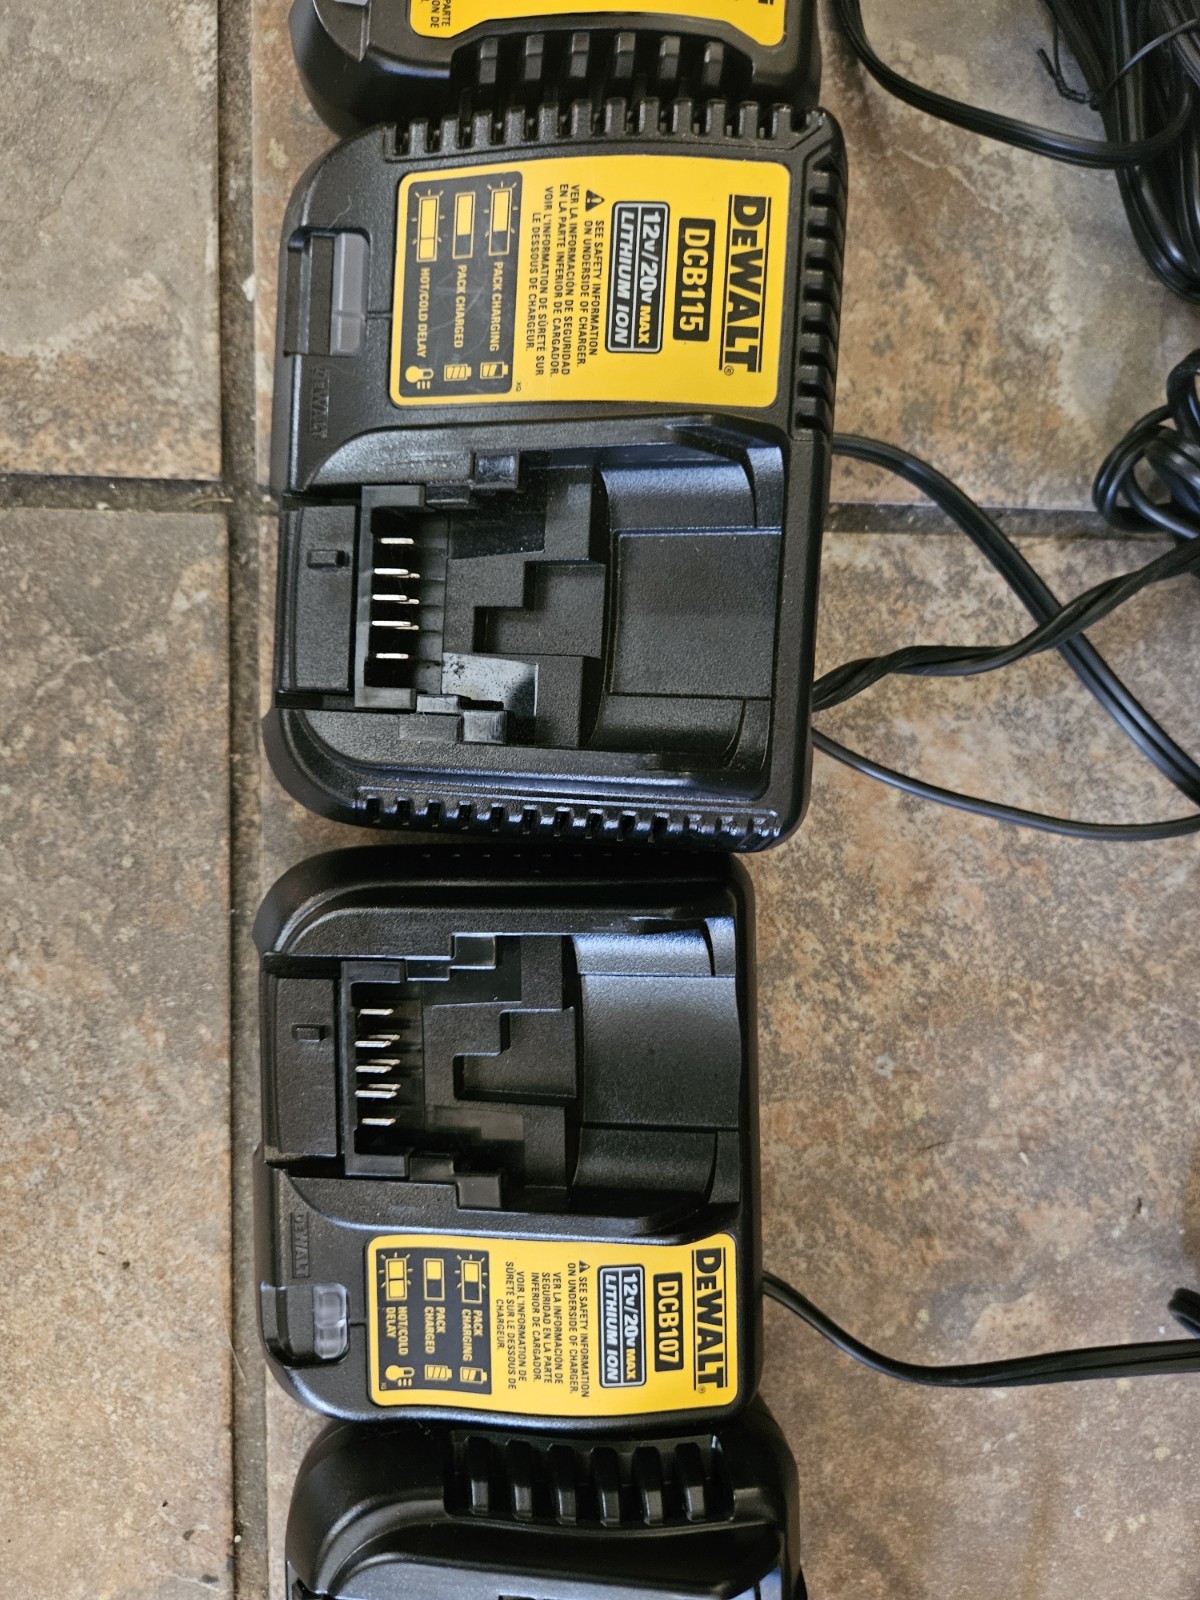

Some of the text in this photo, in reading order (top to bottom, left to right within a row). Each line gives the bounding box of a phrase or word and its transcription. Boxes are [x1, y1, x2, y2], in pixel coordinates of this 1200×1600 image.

[431, 17, 439, 28] DE
[544, 187, 553, 210] VOIR
[570, 208, 578, 219] LA
[571, 185, 579, 203] VER
[539, 214, 551, 294] L'INFORMATION
[615, 211, 634, 344] LITHIUM ION
[526, 212, 541, 351] LE DESSOUS DE CHARGEUR.
[550, 184, 568, 377] EN LA PARTE INFERIOR DE CARGADOR.
[577, 221, 592, 367] ON UNDERSIDE OF CHARGER.
[589, 221, 604, 355] SEE SAFETY INFORMATION
[680, 228, 709, 331] DCB115
[417, 268, 430, 358] HOT/COLD DELAY
[454, 264, 467, 348] PACK CHARGED
[490, 262, 503, 351] PACK CHARGING
[539, 298, 547, 310] DE
[565, 300, 573, 311] DE
[639, 305, 651, 344] MAX
[536, 356, 545, 375] SUR
[562, 316, 572, 375] SEGURIDAD
[553, 1272, 561, 1289] VER
[554, 1292, 561, 1302] LA
[386, 1307, 396, 1338] DELAY
[398, 1307, 408, 1355] HOT/COLD
[425, 1307, 435, 1354] CHARGED
[436, 1307, 445, 1333] PACK
[473, 1310, 483, 1336] PACK
[496, 1299, 505, 1349] CHARGEUR.
[506, 1299, 514, 1316] SUR
[507, 1321, 515, 1329] LE
[517, 1271, 526, 1381] VOIR L'INFORMATION DE
[531, 1272, 541, 1382] INFERIOR DE CARGADOR.
[542, 1272, 552, 1383] SEGURIDAD EN LA PARTE
[568, 1263, 578, 1393] ON UNDERSIDE OF CHARGER.
[605, 1274, 618, 1380] LITHIUM ION
[658, 1281, 679, 1362] DCB107
[462, 1309, 472, 1362] CHARGING
[508, 1333, 516, 1374] DESSOUS
[579, 1277, 589, 1397] SEE SAFETY INFORMATION
[508, 1378, 516, 1390] DE
[555, 1373, 563, 1384] DE
[626, 1349, 636, 1379] MAX
